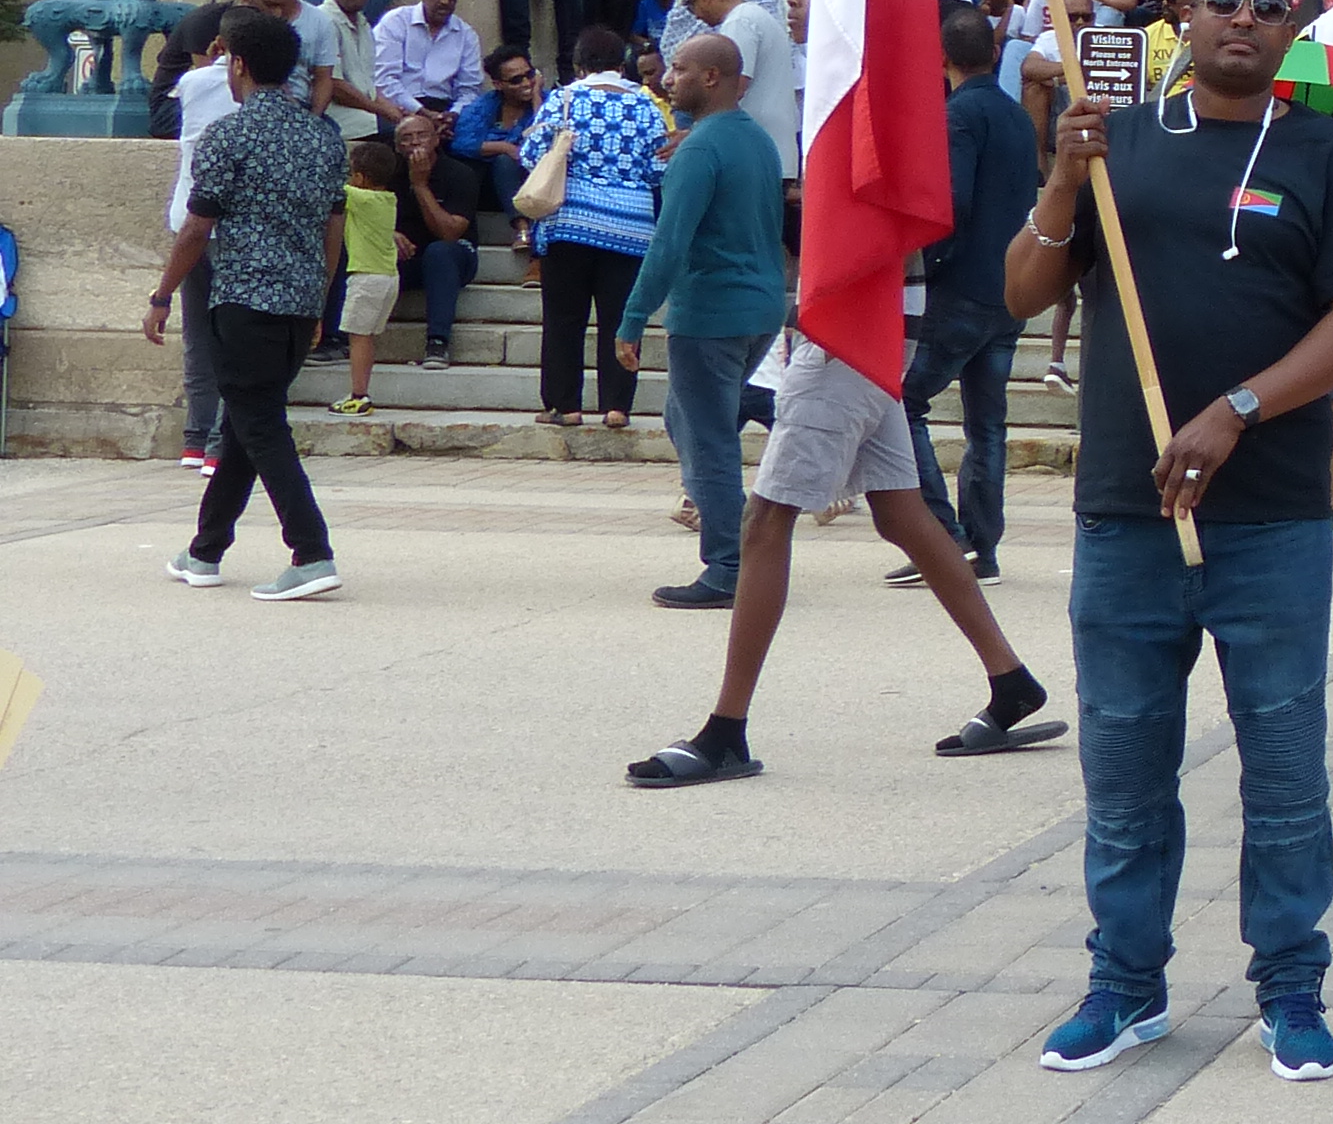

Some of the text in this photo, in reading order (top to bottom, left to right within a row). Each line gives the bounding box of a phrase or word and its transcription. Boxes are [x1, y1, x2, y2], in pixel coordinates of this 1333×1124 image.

[1091, 34, 1133, 45] Visitors
[1087, 81, 1133, 91] Avis aux
